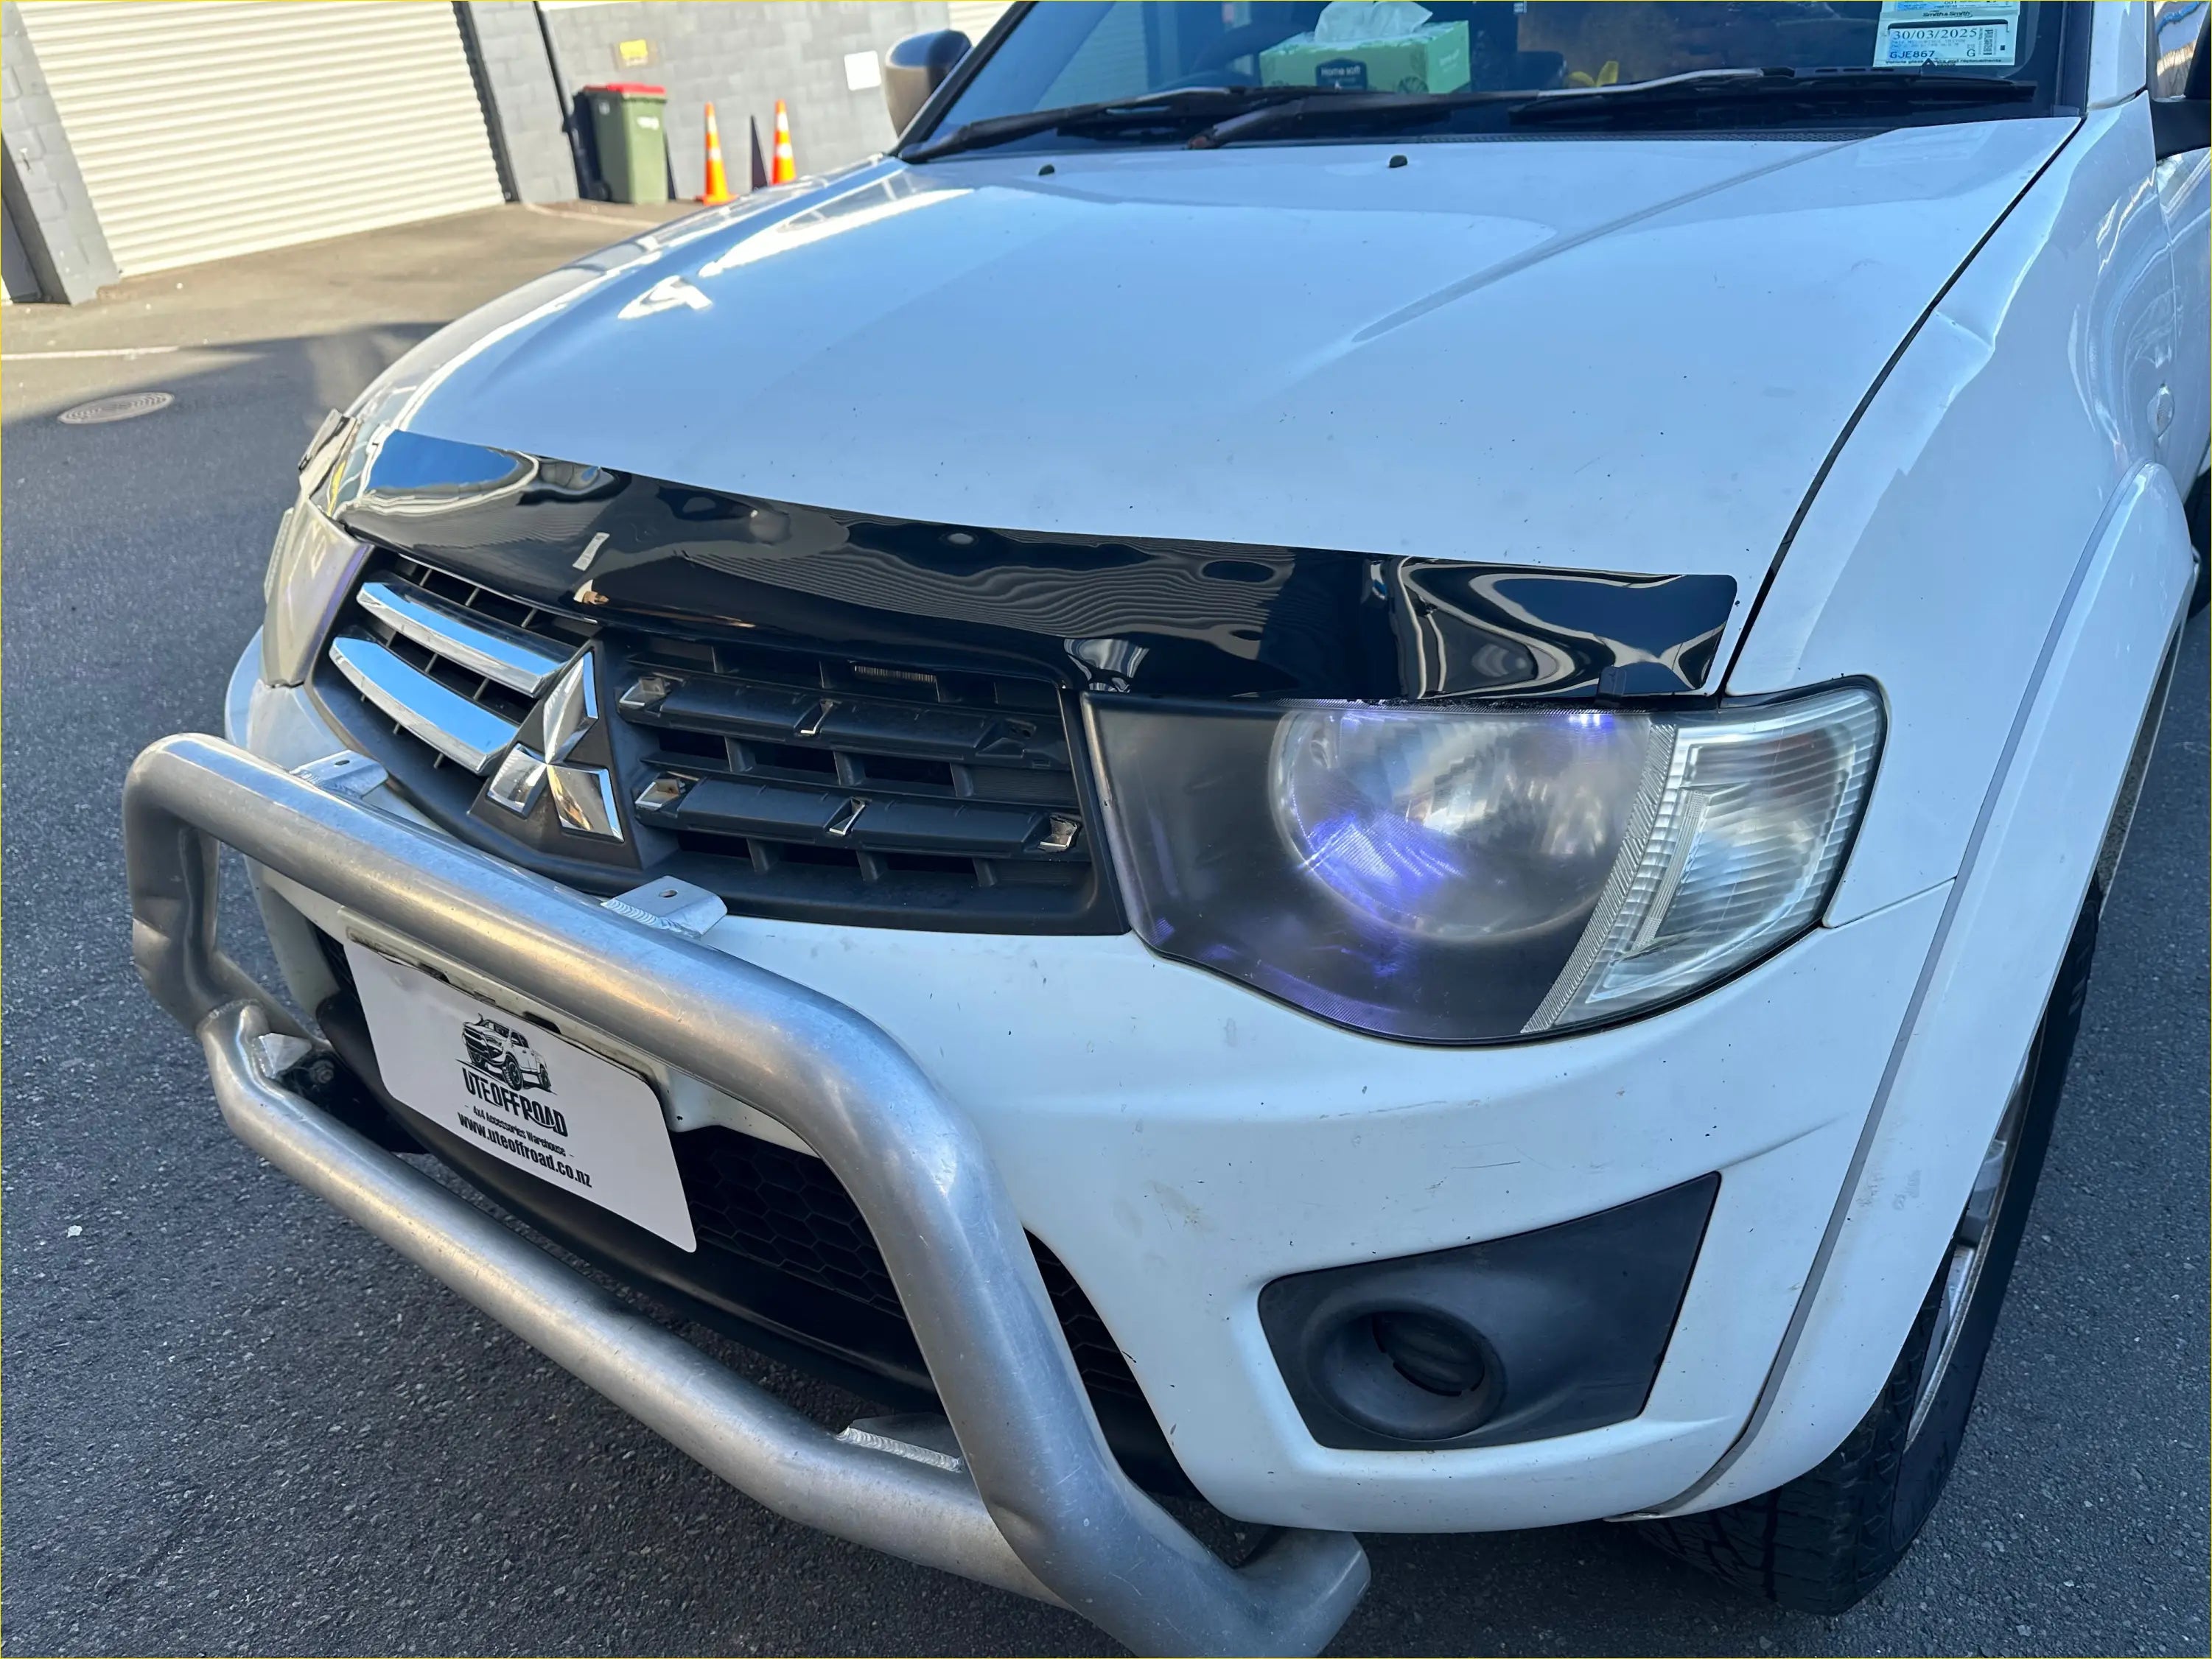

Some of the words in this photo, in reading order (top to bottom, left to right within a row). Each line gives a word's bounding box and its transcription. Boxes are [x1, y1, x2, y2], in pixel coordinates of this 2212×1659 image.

[1893, 29, 1977, 39] 30/03/2025
[1889, 50, 1935, 58] GJE867
[1967, 49, 1975, 57] G
[462, 1067, 568, 1137] UTEOFFROAD
[486, 1112, 526, 1139] Accessories
[526, 1130, 567, 1157] Warehouse
[458, 1112, 592, 1188] www.uteoffroad.co.nz
